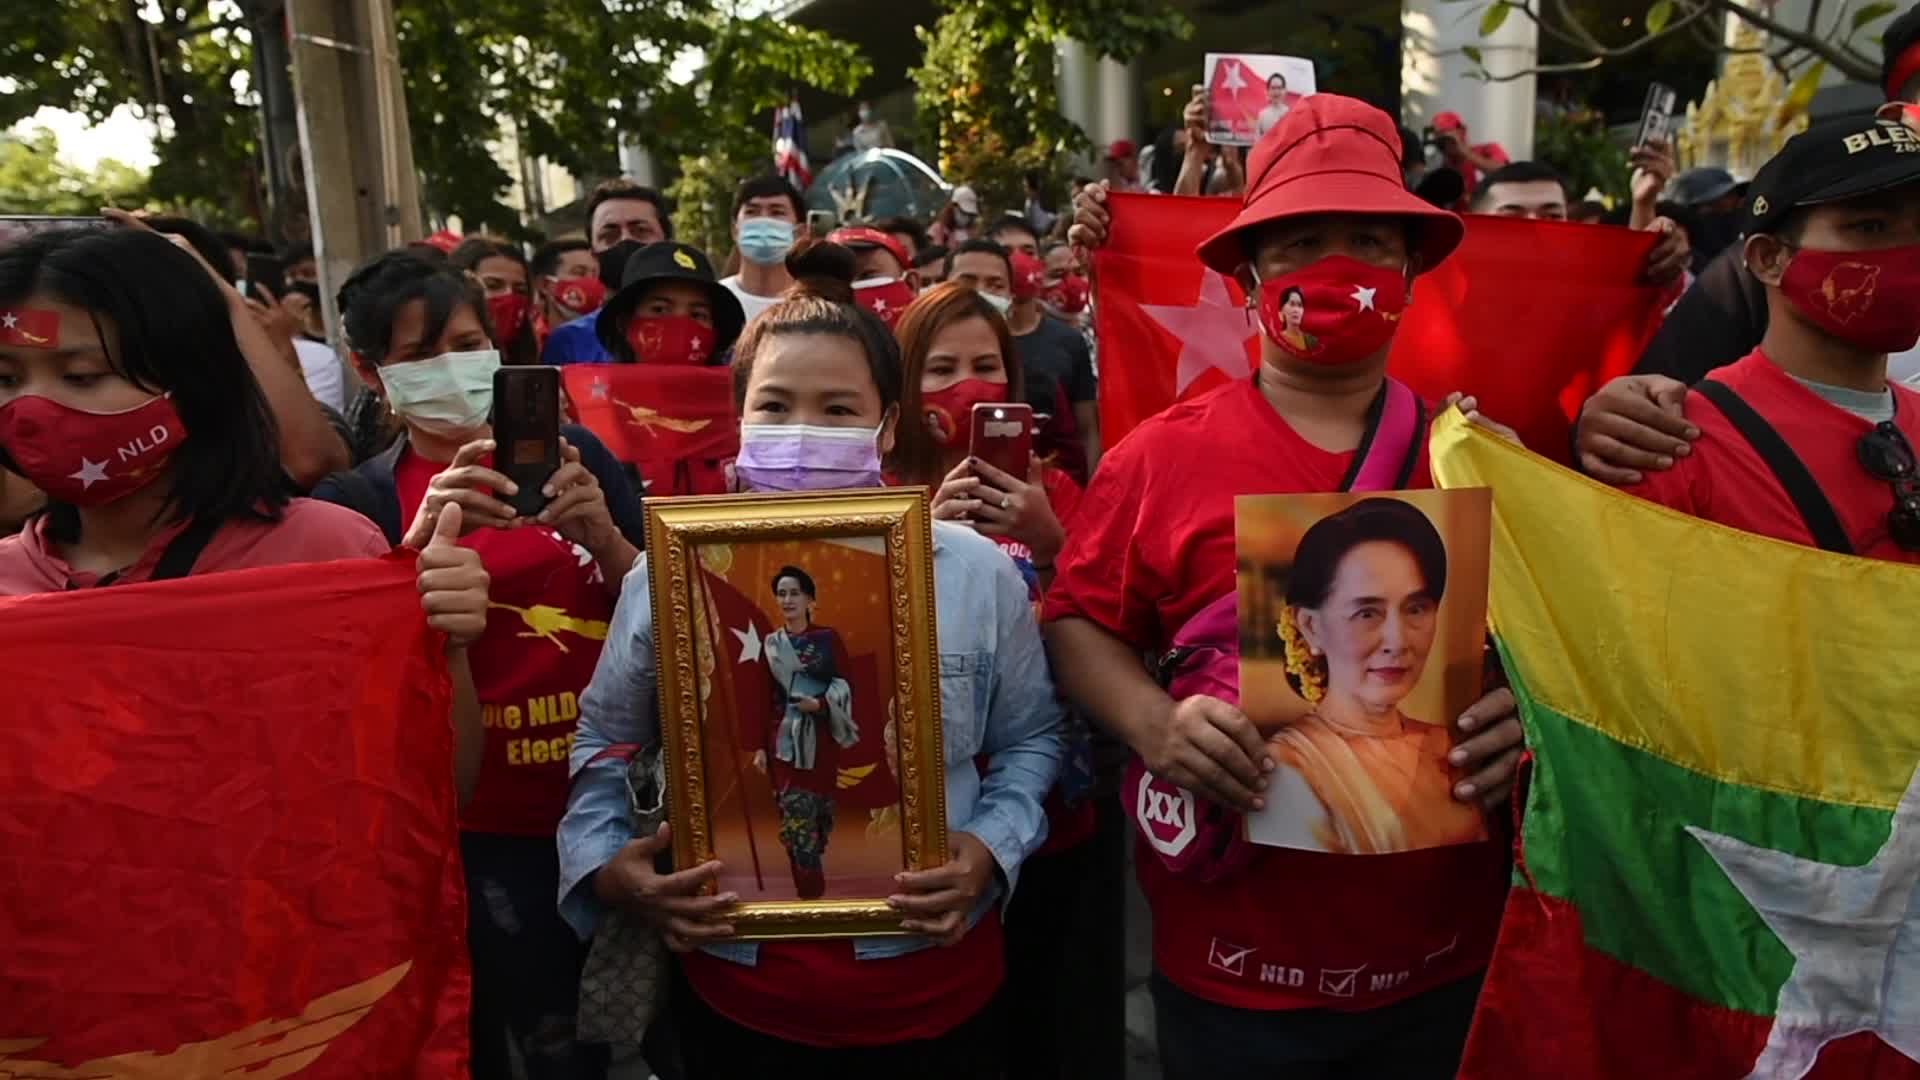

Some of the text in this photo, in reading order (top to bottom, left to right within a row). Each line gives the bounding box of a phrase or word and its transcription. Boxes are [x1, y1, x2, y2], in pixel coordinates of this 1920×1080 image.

[117, 424, 168, 462] NLD
[527, 691, 577, 727] NLD
[1146, 788, 1184, 828] XX
[1260, 963, 1304, 987] NLD
